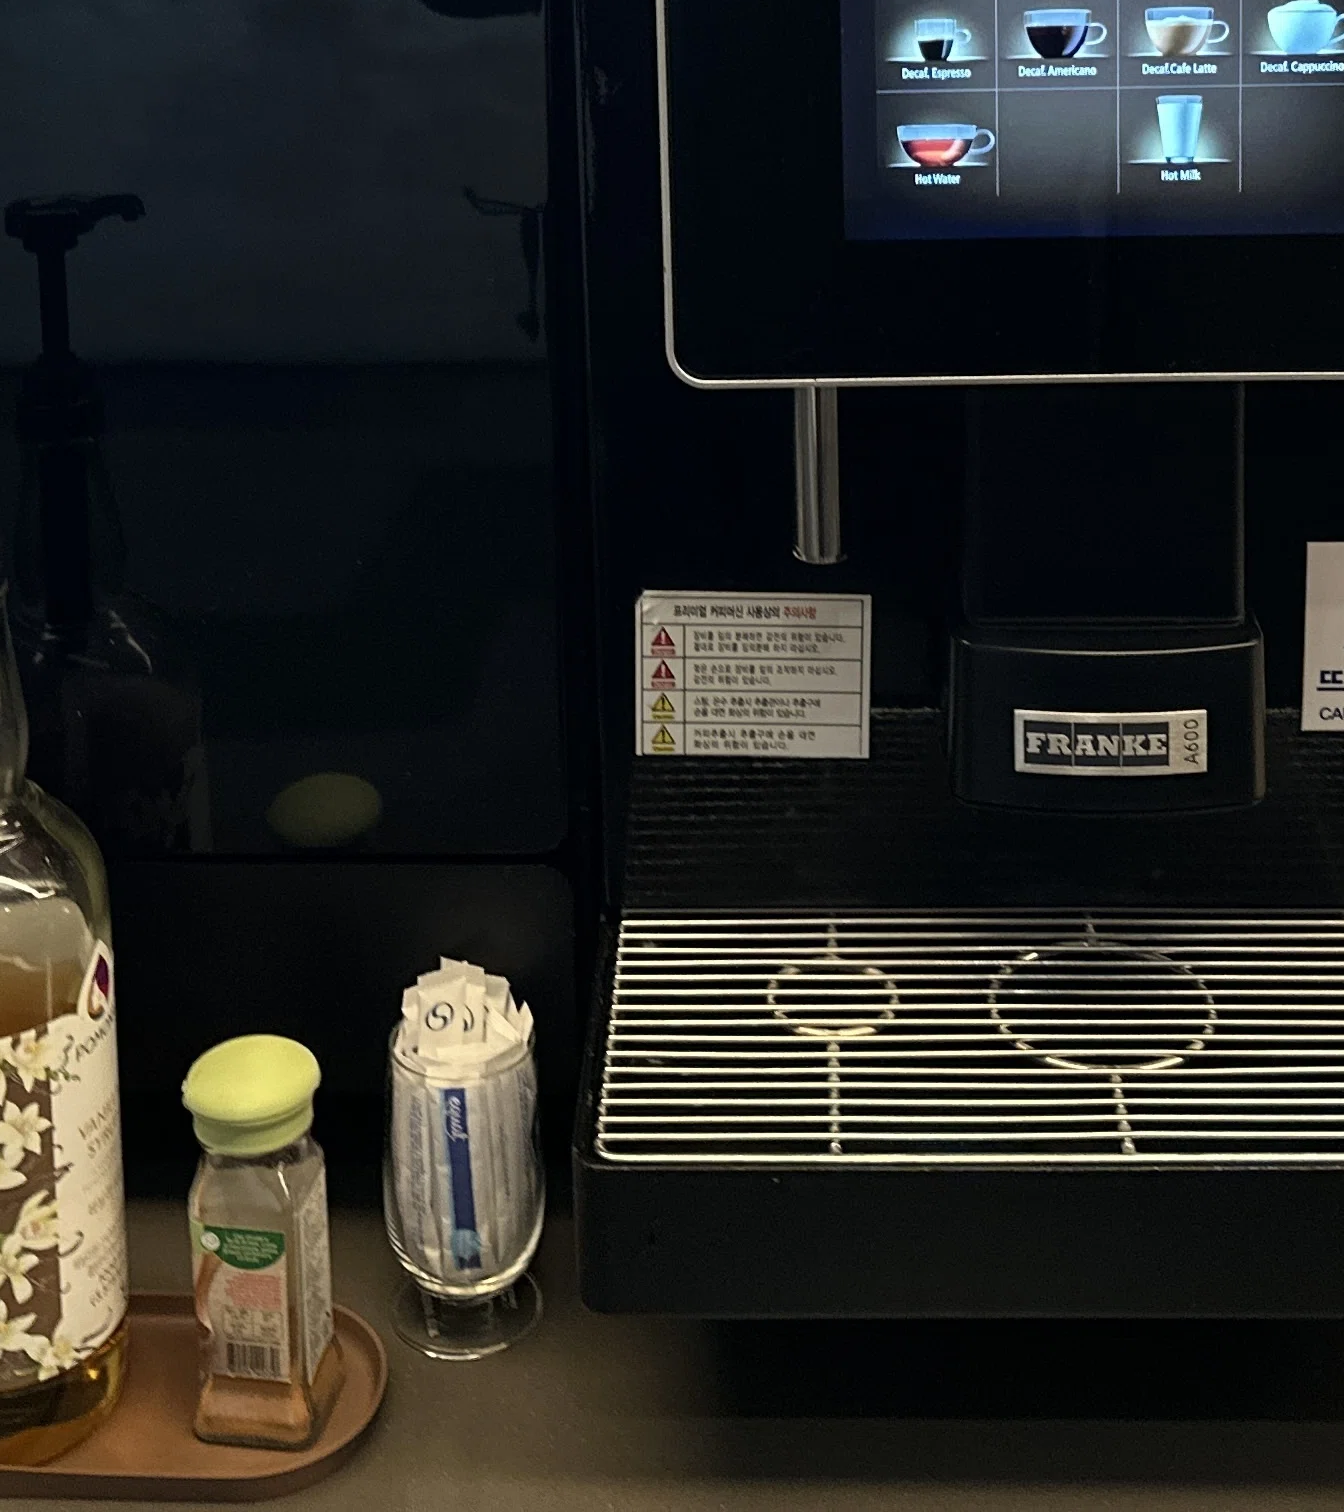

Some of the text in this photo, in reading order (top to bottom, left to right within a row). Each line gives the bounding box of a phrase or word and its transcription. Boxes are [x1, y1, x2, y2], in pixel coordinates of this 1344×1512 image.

[901, 67, 971, 81] Decaf. Espresso
[1018, 64, 1097, 77] Decaf. Americano
[1170, 62, 1190, 75] Cafe
[1192, 62, 1218, 75] Latte
[1260, 60, 1344, 75] Decaf. Cappuccino
[915, 173, 960, 185] Hot Water
[1160, 169, 1201, 181] Hot Milk
[673, 605, 706, 617] 프리미엄
[710, 605, 744, 618] 커피머신
[746, 606, 780, 619] 사용상의
[1025, 731, 1169, 757] FRANKE
[1183, 719, 1200, 764] A600
